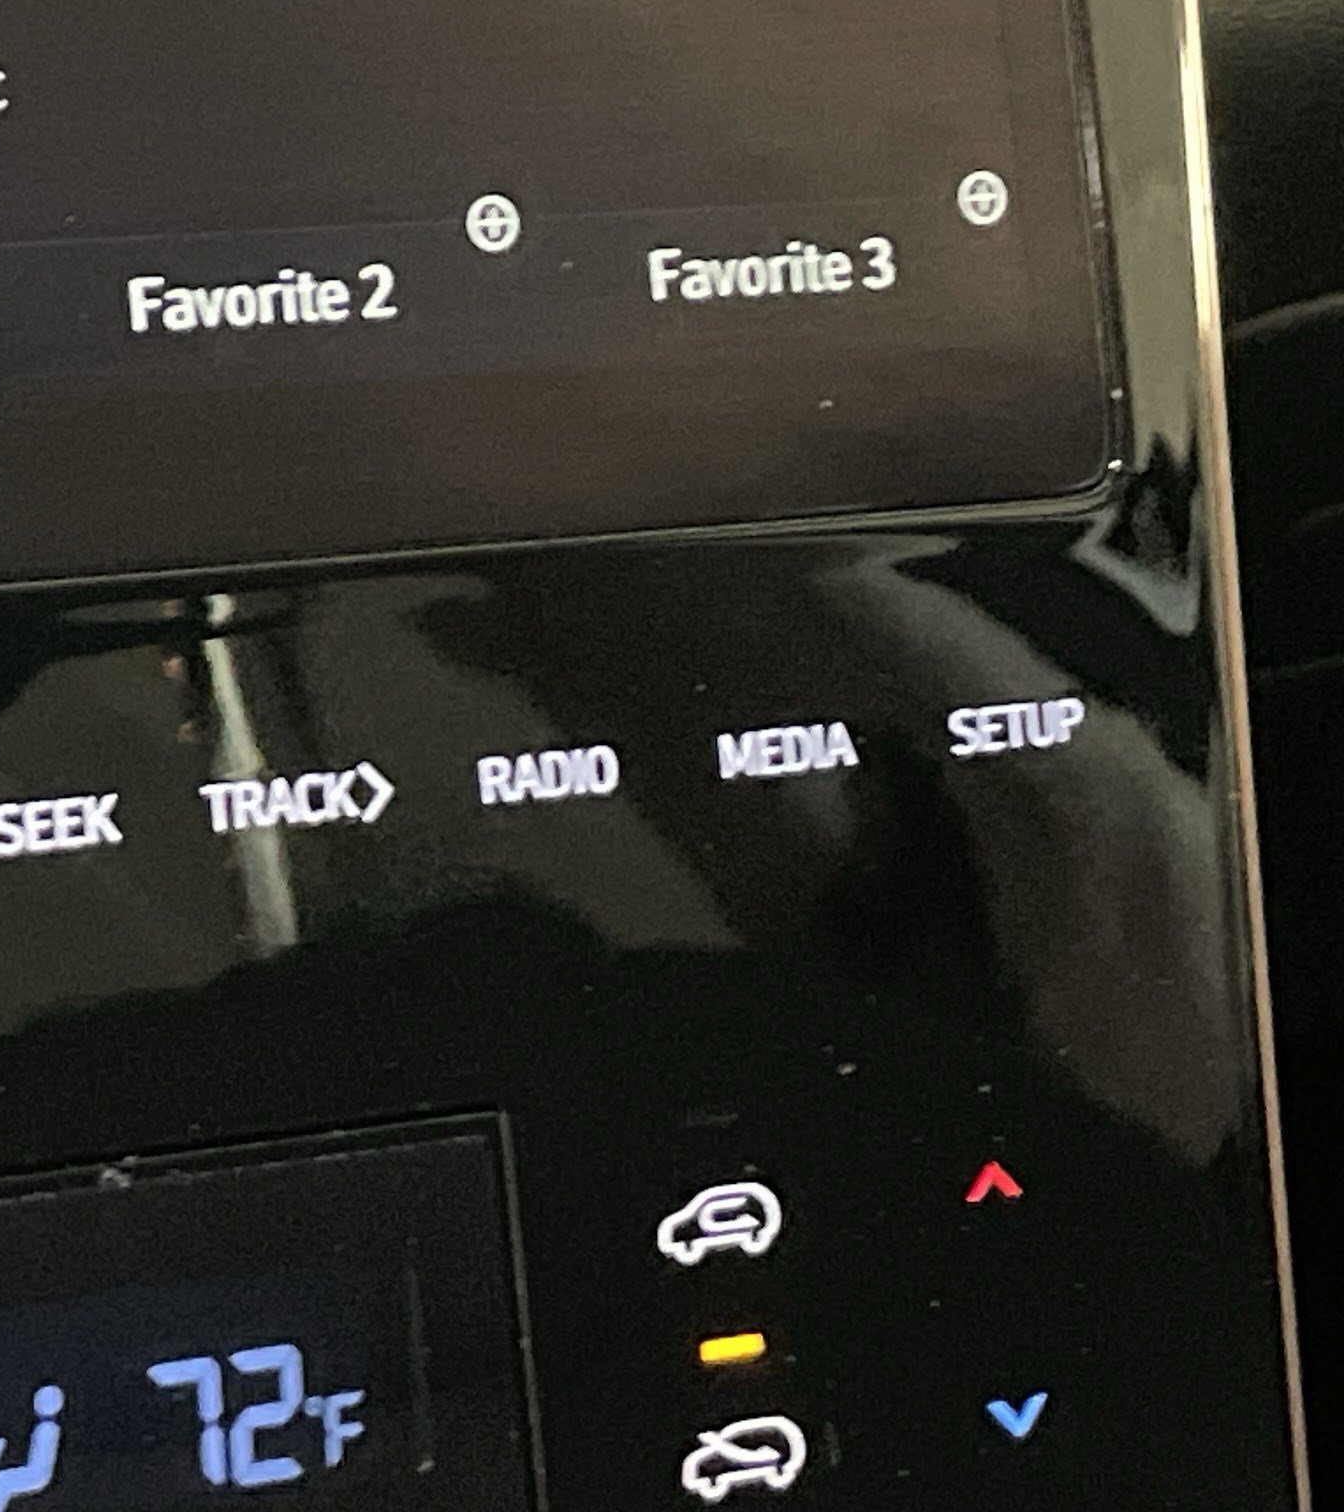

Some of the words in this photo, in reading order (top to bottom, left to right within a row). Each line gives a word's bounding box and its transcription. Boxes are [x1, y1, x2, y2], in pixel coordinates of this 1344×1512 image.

[127, 267, 351, 333] Favorite
[357, 262, 399, 320] 2
[647, 240, 854, 302] Favorite
[858, 236, 897, 291] 3
[716, 720, 860, 780] MEDIA
[946, 696, 1086, 757] SETUP
[476, 744, 620, 806] RADIO
